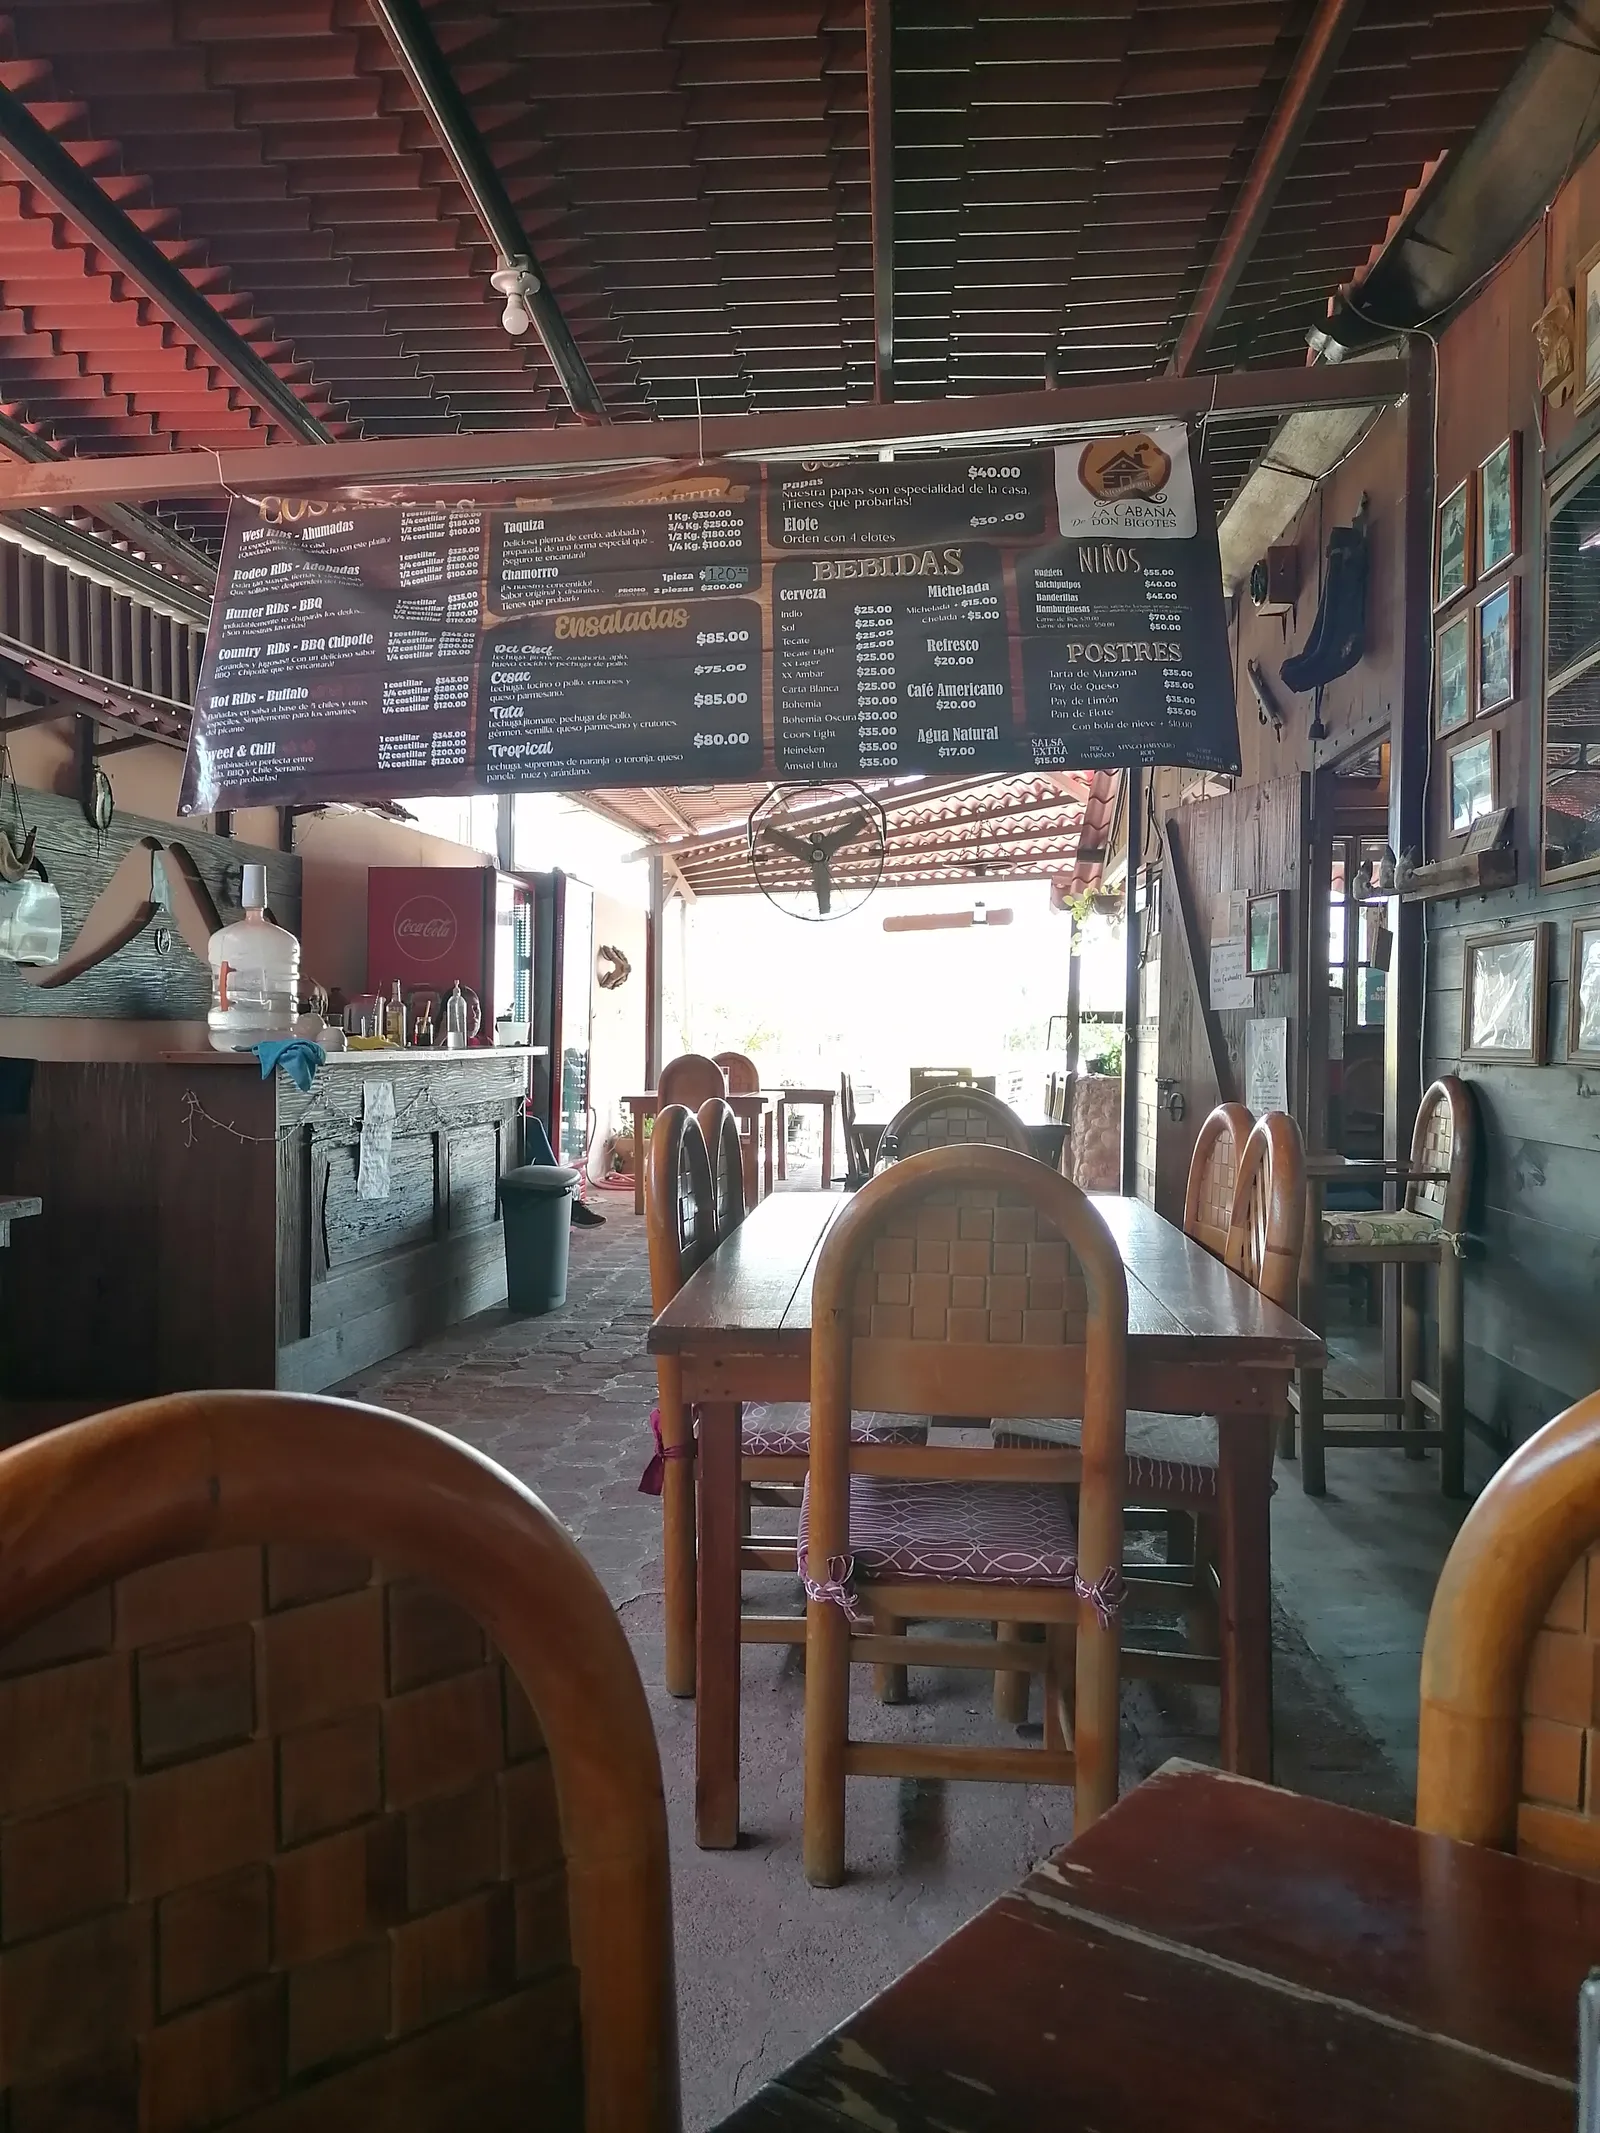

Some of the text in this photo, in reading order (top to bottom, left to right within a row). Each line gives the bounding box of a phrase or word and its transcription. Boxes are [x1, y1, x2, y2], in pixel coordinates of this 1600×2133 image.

[968, 465, 1021, 480] $40.00
[782, 478, 824, 490] Papas
[782, 483, 1031, 498] Nuestra papas son especialidad de la casa.
[782, 497, 912, 512] ¡Tienes que probarlas!
[1114, 503, 1177, 518] CABAÑA
[674, 512, 690, 522] Kg.
[692, 509, 732, 520] $330.00
[504, 520, 545, 534] Taquiza
[668, 519, 744, 531] 3/4 Kg. $250.00
[784, 516, 819, 532] Elote
[1092, 517, 1177, 528] DON BIGOTES
[242, 528, 265, 543] West
[302, 520, 354, 541] Ahumadas
[668, 529, 742, 542] 1/2 Kg. $180.00
[782, 532, 896, 544] Orden con 4 elotes
[668, 539, 742, 552] 1/4 Kg. $100.00
[812, 548, 964, 582] BEBIDAS
[1078, 543, 1142, 574] NIÑOS
[233, 561, 360, 581] Rodeo Ribs Adobadas
[1034, 568, 1174, 578] Nuggets $55.00
[662, 586, 694, 594] piezas
[700, 583, 743, 592] $200.00
[928, 582, 990, 598] Michelada
[1035, 580, 1177, 590] Salchipulpos $40.00
[780, 587, 827, 600] Cerveza
[1036, 592, 1178, 602] Banderillas $45.00
[225, 597, 323, 620] Hunter Ribs BBQ
[781, 605, 892, 618] Indio $25.00
[906, 596, 998, 614] Michelada $15.00
[1036, 604, 1091, 614] Hamburguesas
[967, 610, 1000, 622] $5.00
[1148, 613, 1181, 622] $70.00
[554, 606, 690, 640] Ensaladas
[782, 618, 894, 632] Sol $25.00
[1150, 622, 1182, 632] $50.00
[696, 630, 749, 647] $85.00
[782, 630, 894, 646] Tecate $25.00
[218, 633, 374, 660] Country Ribs BBQ Chipotle
[521, 644, 554, 656] Chef
[813, 648, 835, 656] Light
[856, 640, 895, 650] $25.00
[926, 638, 980, 652] Refresco
[856, 652, 896, 663] $25.00
[1066, 641, 1183, 664] POSTRES
[934, 656, 974, 667] $20.00
[694, 663, 747, 676] $75.00
[796, 666, 896, 678] Ambar $25.00
[1076, 670, 1090, 678] de
[1093, 668, 1138, 678] Manzana
[1162, 668, 1194, 678] $35.00
[782, 682, 896, 694] Carta Blanca $25.00
[907, 682, 1004, 698] Café Americano
[1049, 680, 1194, 693] Pay de Queso $35.00
[210, 687, 309, 709] Hot Ribs Buffalo
[693, 692, 748, 708] $85.00
[782, 696, 898, 709] Bohemia $30.00
[1050, 694, 1196, 708] Pay de Limón $35.00
[936, 699, 977, 711] $20.00
[489, 705, 524, 720] Tata
[782, 710, 898, 724] Bohemia Oscura $30.00
[1051, 706, 1197, 719] Pan de Elote $35.00
[385, 730, 467, 742] costillar $345.00
[783, 726, 898, 740] Coors Light $35.00
[917, 726, 999, 744] Agua Natural
[379, 740, 467, 752] 3/4 costillar $280.00
[693, 732, 750, 749] $80.00
[1031, 737, 1064, 748] SALSA
[236, 742, 276, 758] & Chili
[378, 748, 467, 760] 1/2 costillar $200.00
[488, 740, 554, 758] Tropical
[783, 742, 898, 756] Heineken $35.00
[938, 746, 976, 758] $17.00
[1032, 746, 1069, 757] EXTRA
[378, 757, 465, 769] 1/4 costillar $120.00
[784, 756, 898, 770] Amstel Ultra $35.00
[1034, 756, 1066, 766] $15.00
[398, 918, 452, 938] Coca-Cola
